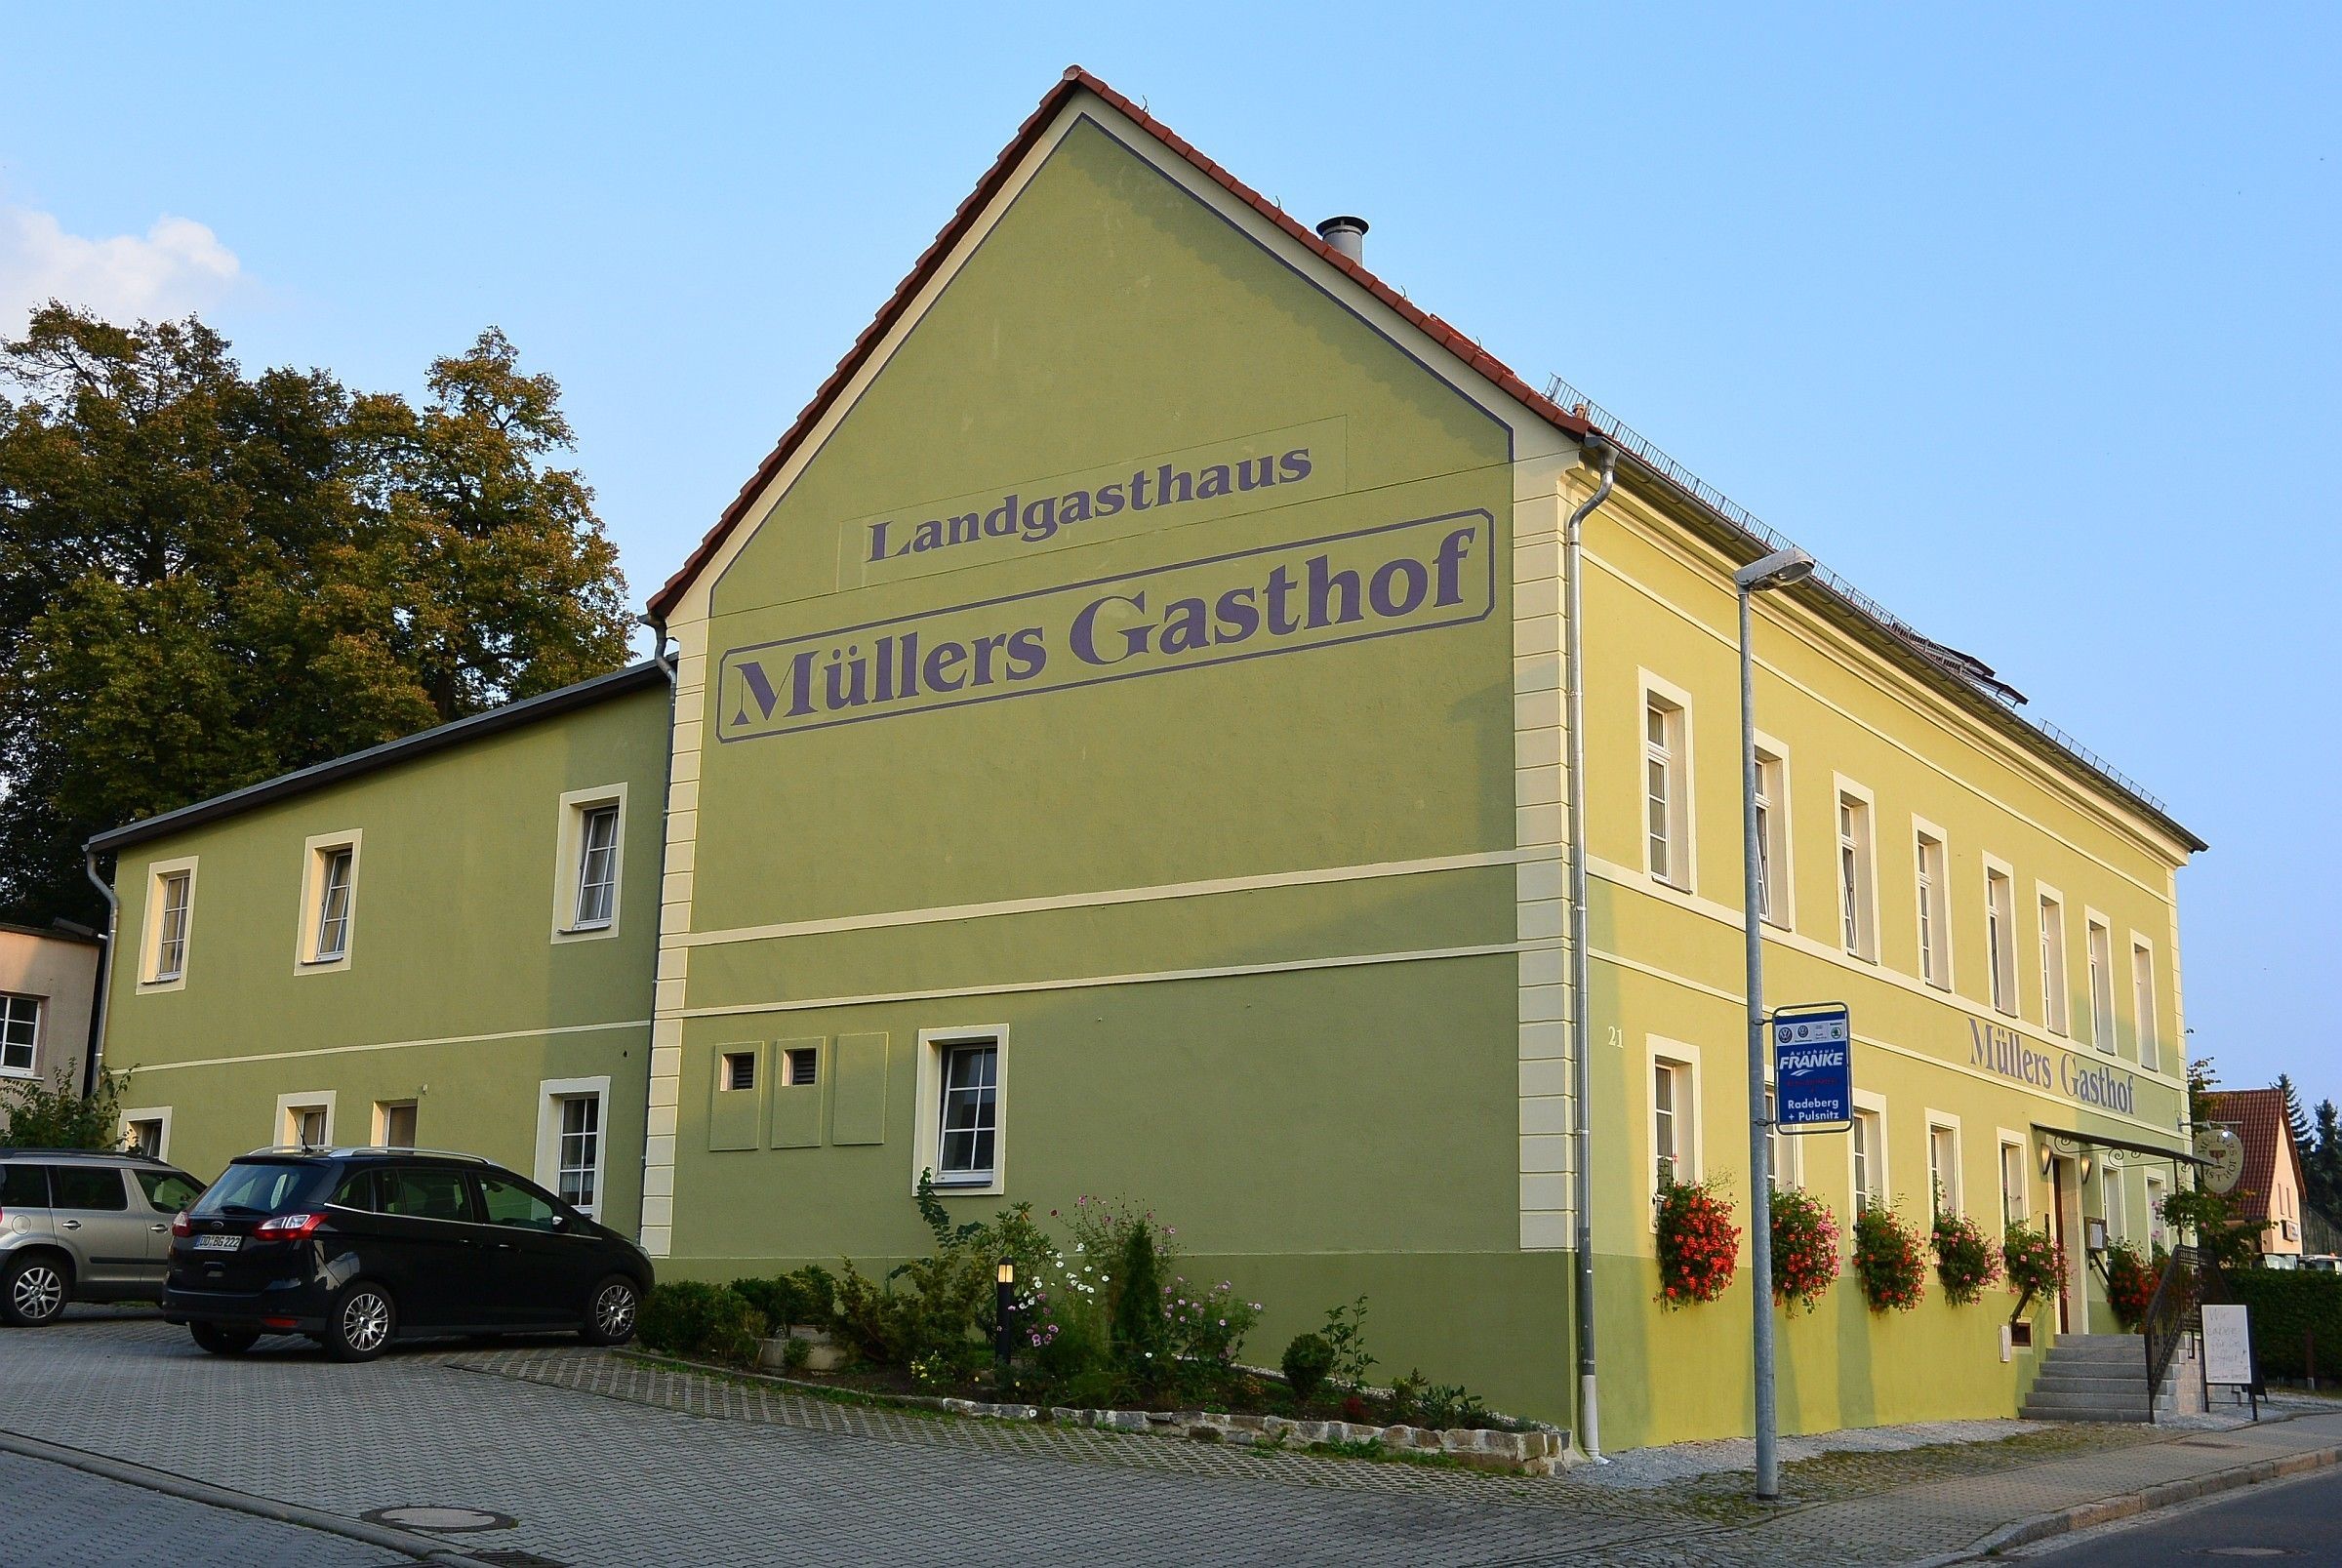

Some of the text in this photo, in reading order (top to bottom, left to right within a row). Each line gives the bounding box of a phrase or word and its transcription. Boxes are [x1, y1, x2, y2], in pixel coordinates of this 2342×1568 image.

[868, 446, 1312, 563] Landgasthaus
[731, 527, 1475, 728] Müllers Gasthof
[1608, 1025, 1624, 1049] 21
[1779, 1052, 1844, 1070] FRANKE
[1968, 1017, 2134, 1115] Müllers Gasthof
[1788, 1098, 1839, 1110] Radeberg
[1798, 1110, 1839, 1121] Pulsnitz
[224, 1236, 241, 1248] 222
